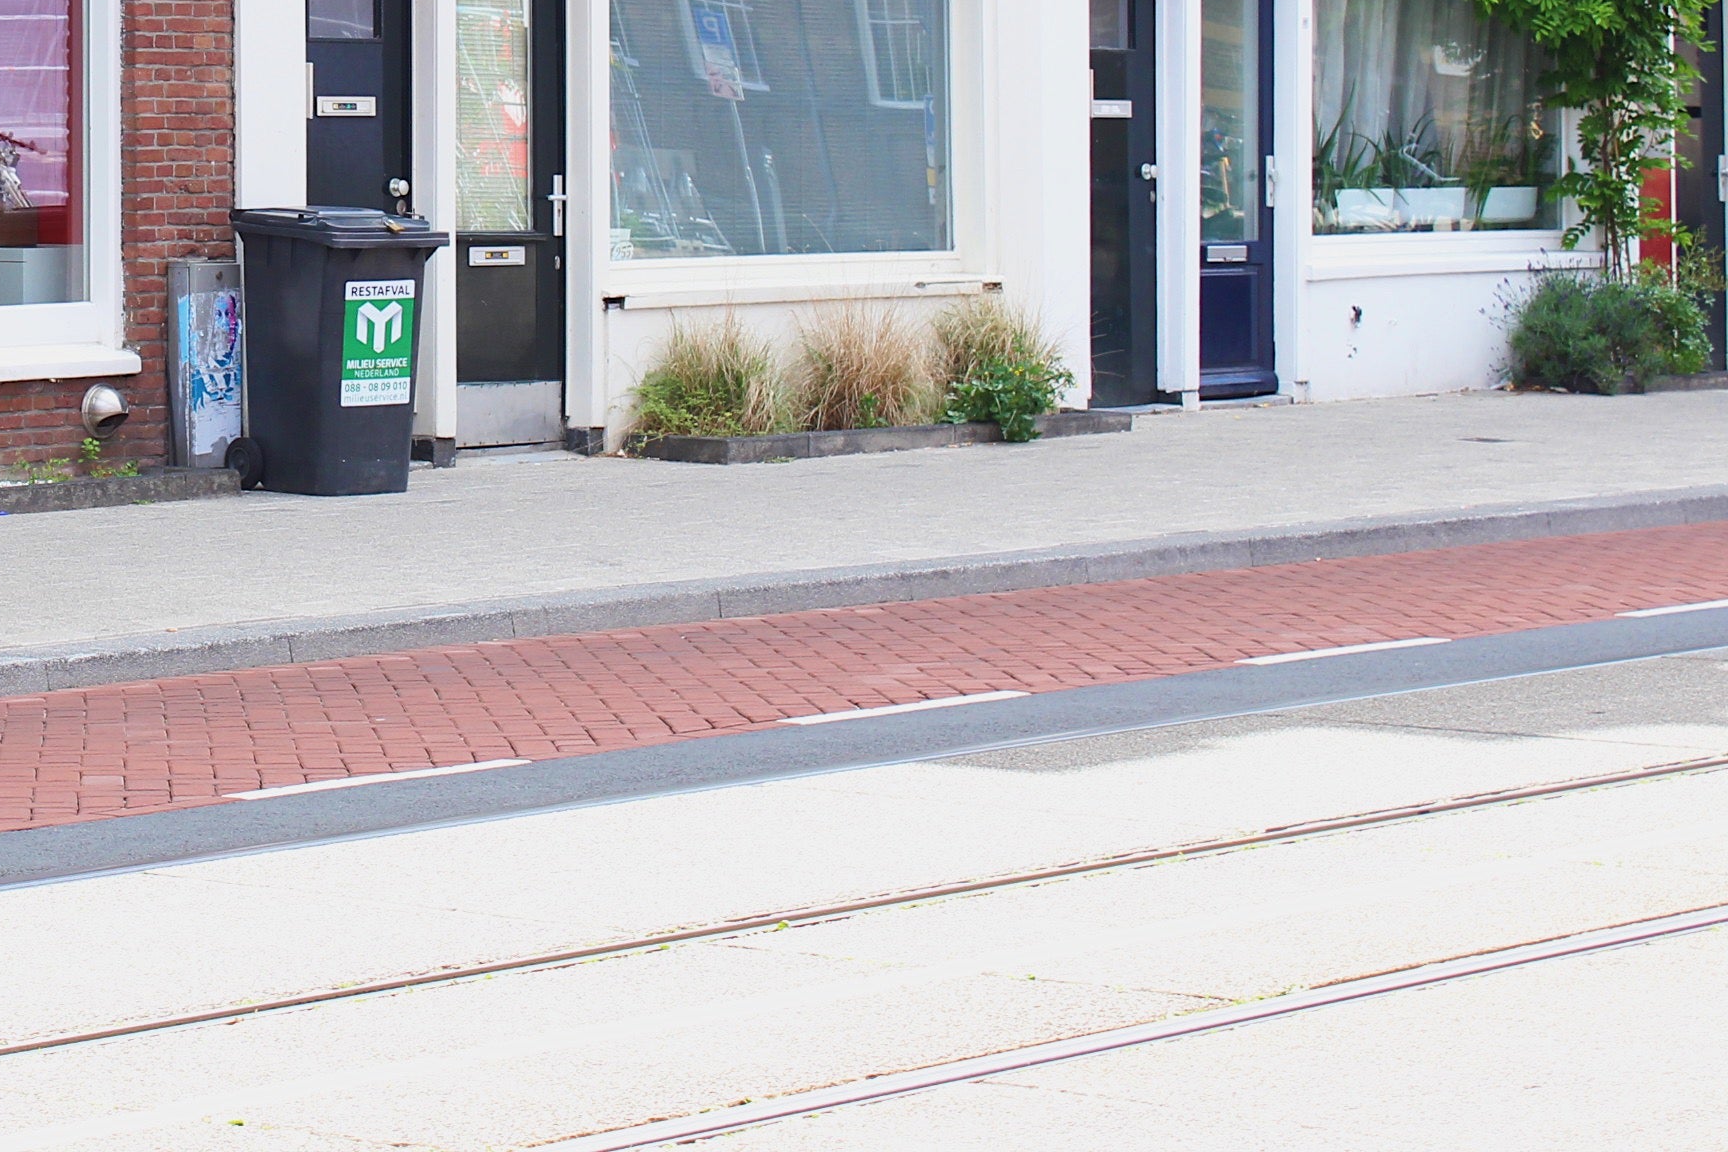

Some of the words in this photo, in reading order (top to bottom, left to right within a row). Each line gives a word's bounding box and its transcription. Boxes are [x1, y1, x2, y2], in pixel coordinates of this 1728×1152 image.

[351, 285, 410, 297] RESTAFVAL
[346, 359, 375, 370] MILIEU
[376, 357, 408, 369] SERVICE
[354, 368, 400, 378] NEDERLAND
[344, 383, 361, 393] 088
[368, 382, 381, 392] 08
[382, 382, 391, 391] 09
[393, 380, 408, 390] 010
[343, 392, 408, 404] milieuservice.nl
